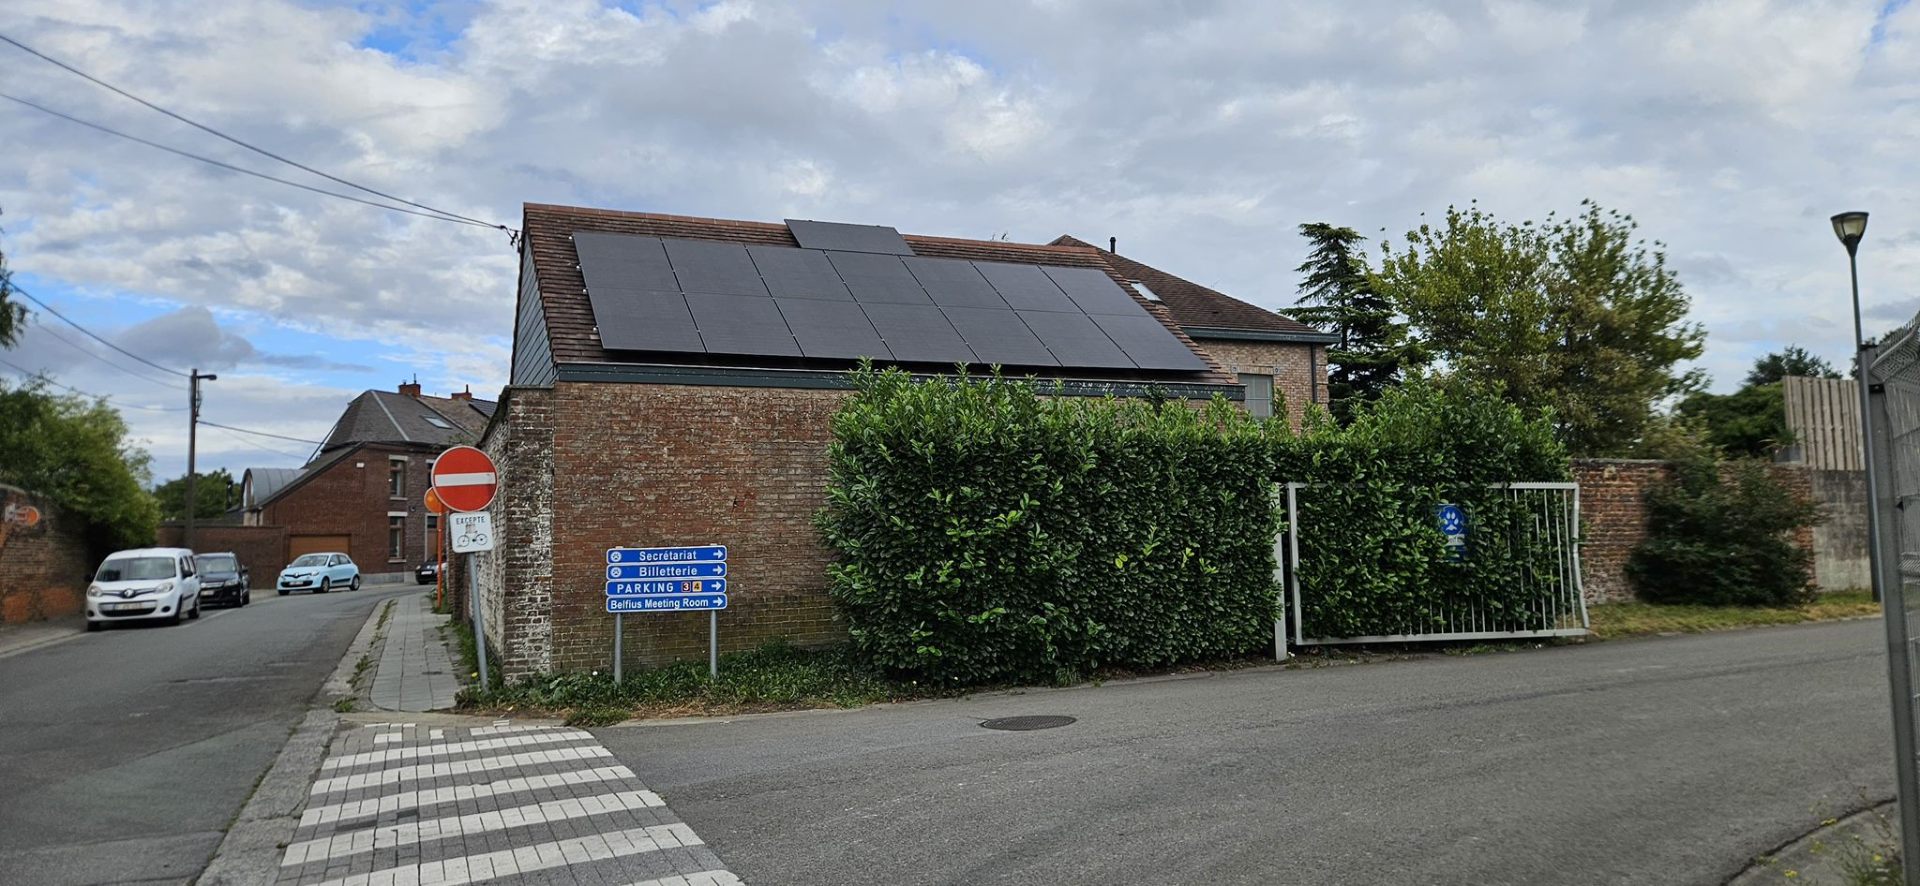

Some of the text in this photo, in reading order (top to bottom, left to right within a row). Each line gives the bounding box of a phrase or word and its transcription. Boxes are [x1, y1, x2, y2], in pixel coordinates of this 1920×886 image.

[640, 551, 697, 560] Secrétariat
[640, 566, 698, 576] Billetterie
[617, 582, 701, 593] PARKING 3 4
[611, 598, 709, 609] Belfius Meeting Room
